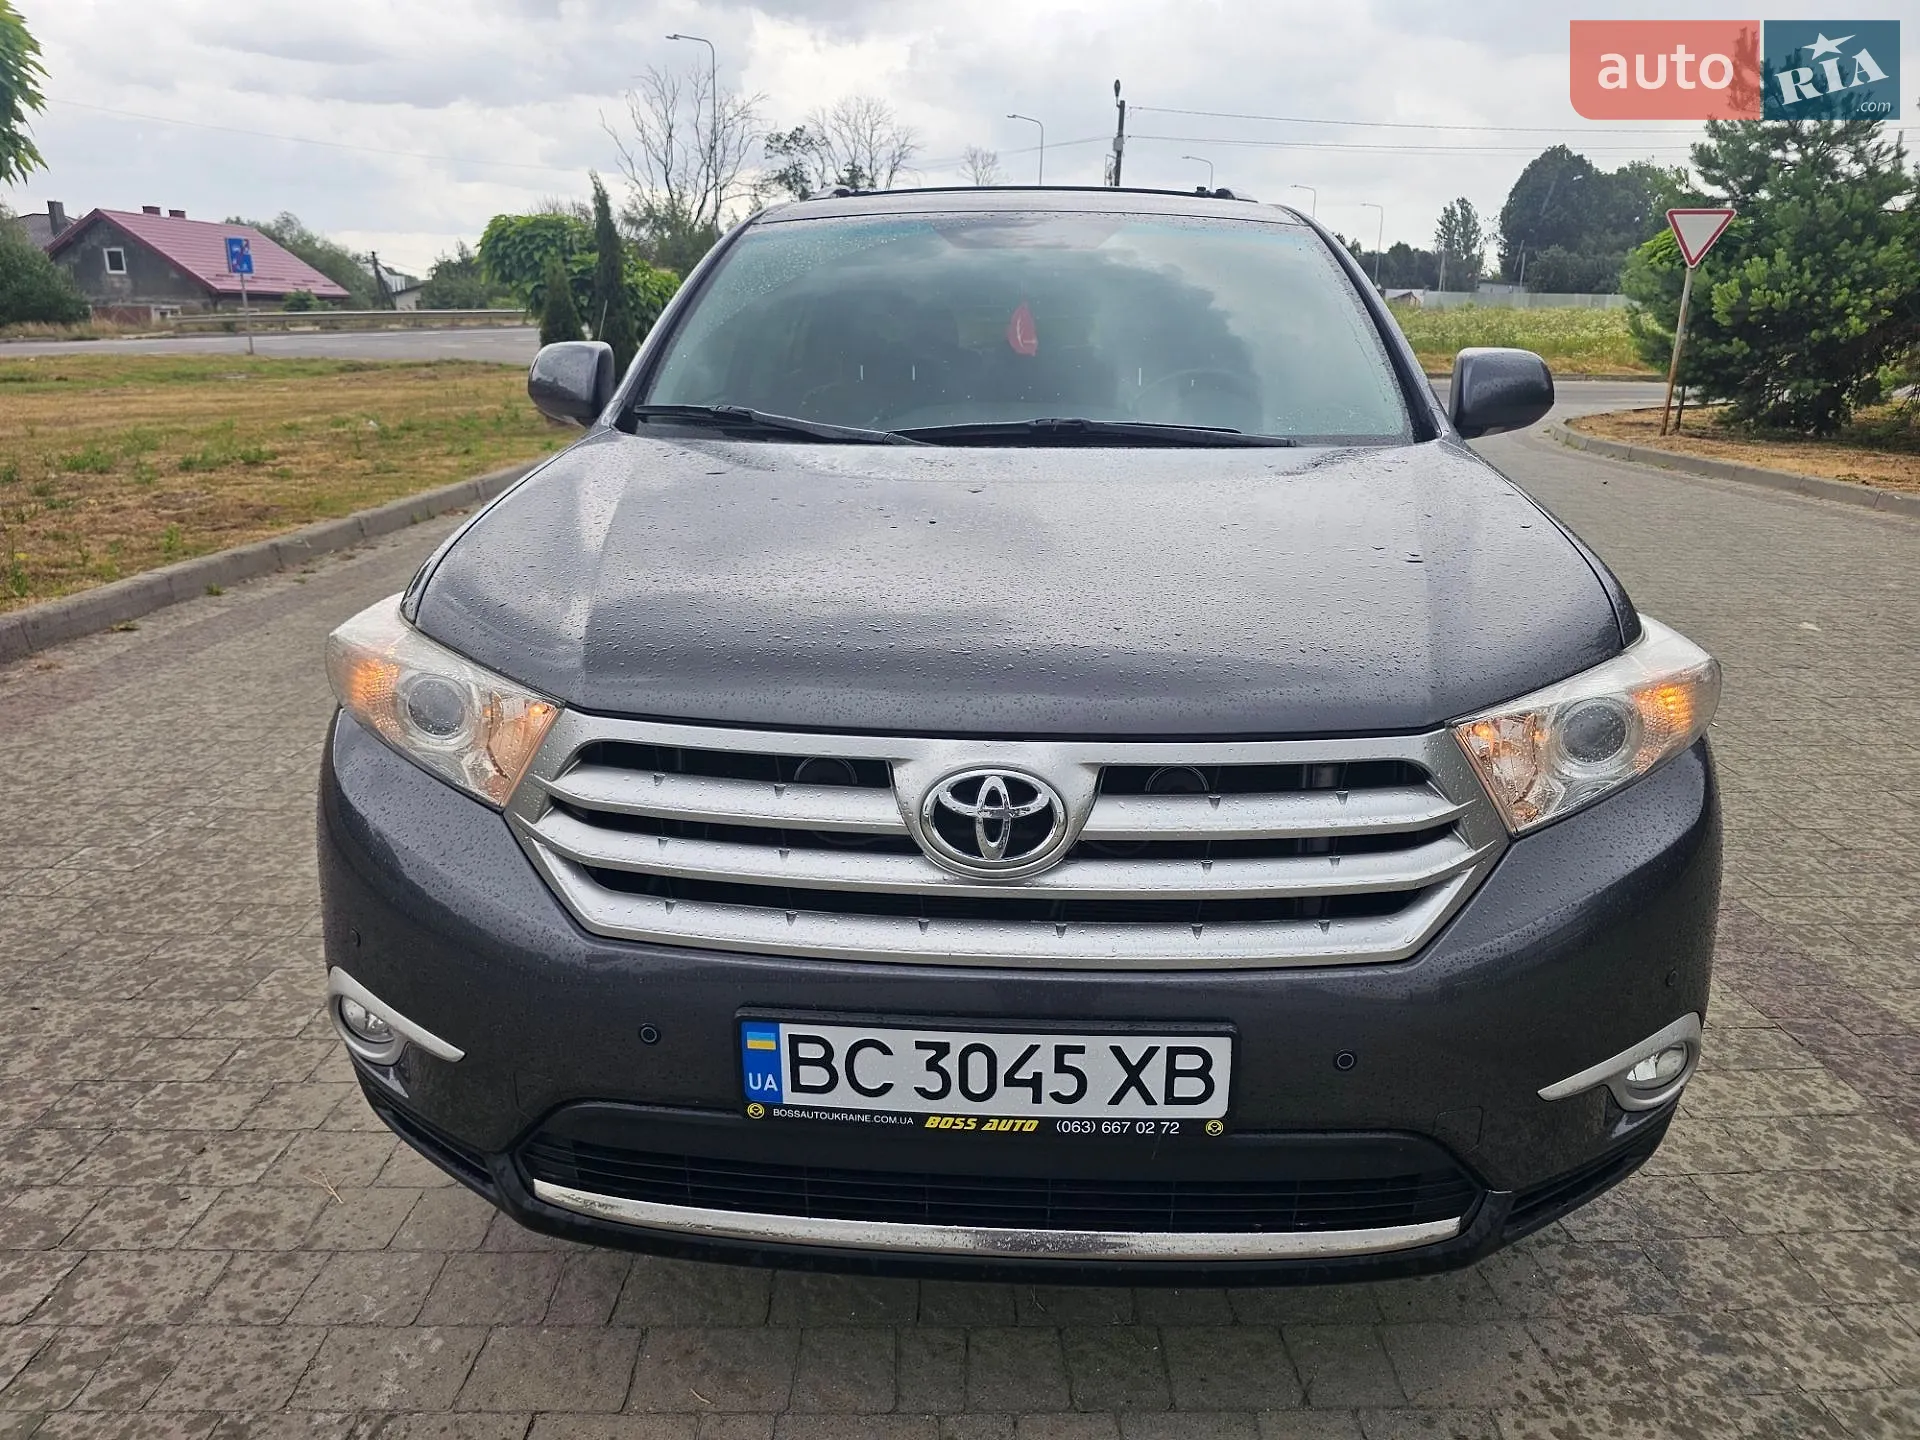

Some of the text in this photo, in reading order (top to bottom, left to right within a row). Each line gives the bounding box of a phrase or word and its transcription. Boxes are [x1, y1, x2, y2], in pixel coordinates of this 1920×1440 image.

[788, 1034, 1215, 1106] BC 3045 XB
[748, 1072, 779, 1092] UA
[773, 1108, 914, 1125] BOSSAUTOUKRAINE.COM.UA
[924, 1116, 1040, 1132] BOSS AUTO
[1056, 1120, 1180, 1134] (063) 667 02 72
